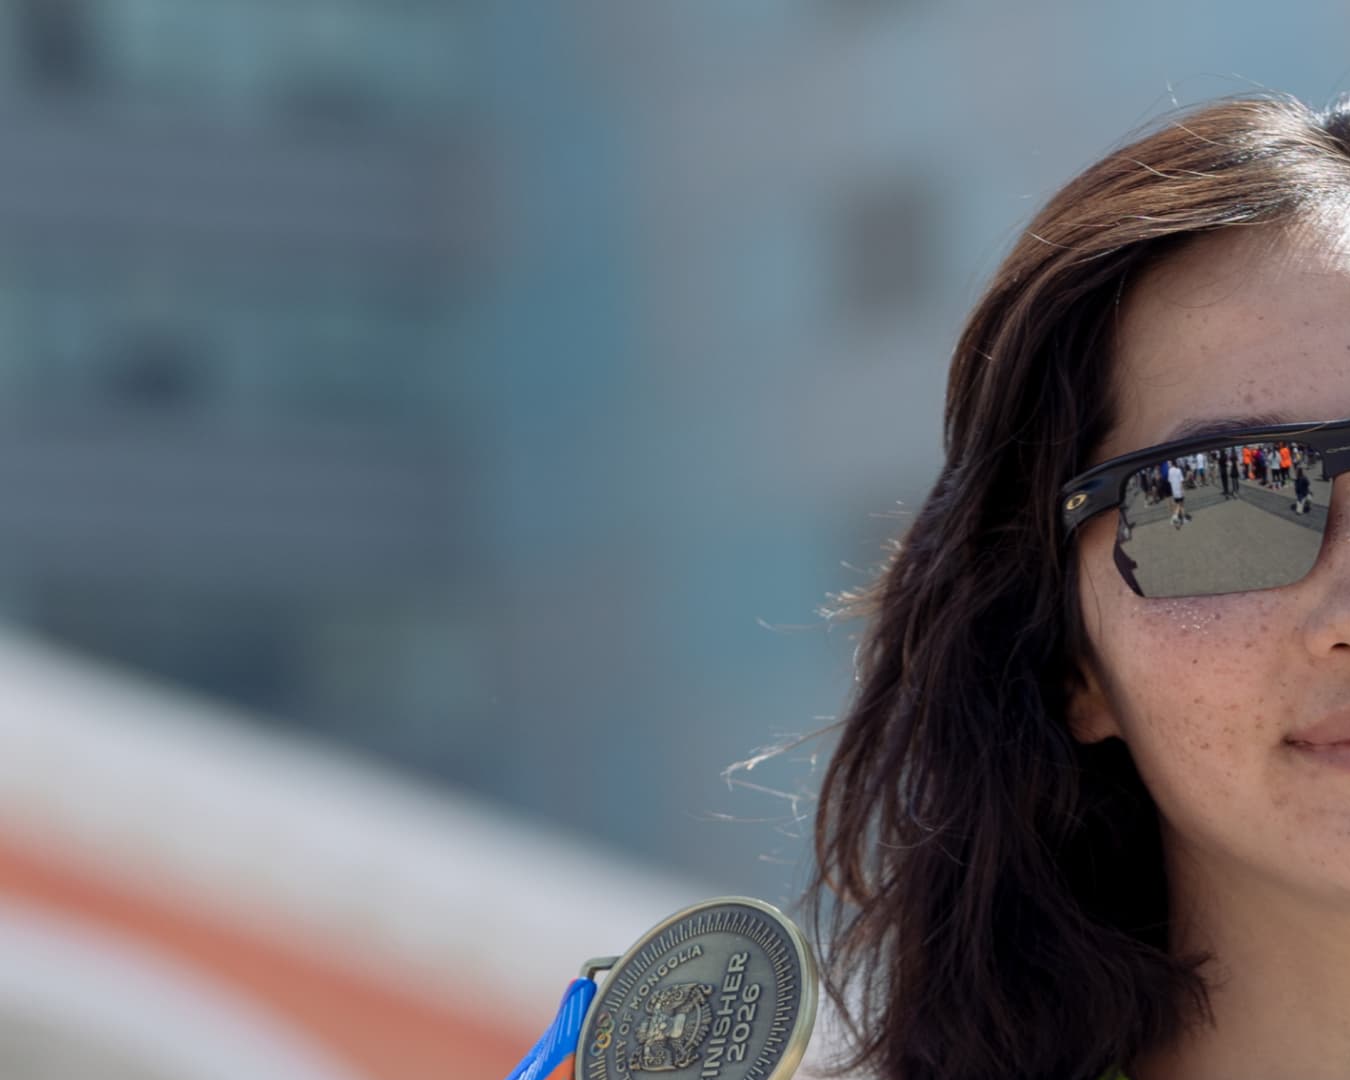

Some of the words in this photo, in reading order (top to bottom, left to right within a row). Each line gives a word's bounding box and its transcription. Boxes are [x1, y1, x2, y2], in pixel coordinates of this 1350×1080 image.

[630, 945, 702, 1010] MONGOLIA
[619, 1011, 633, 1036] OF
[727, 983, 761, 1062] 2026
[616, 1039, 627, 1072] CITY
